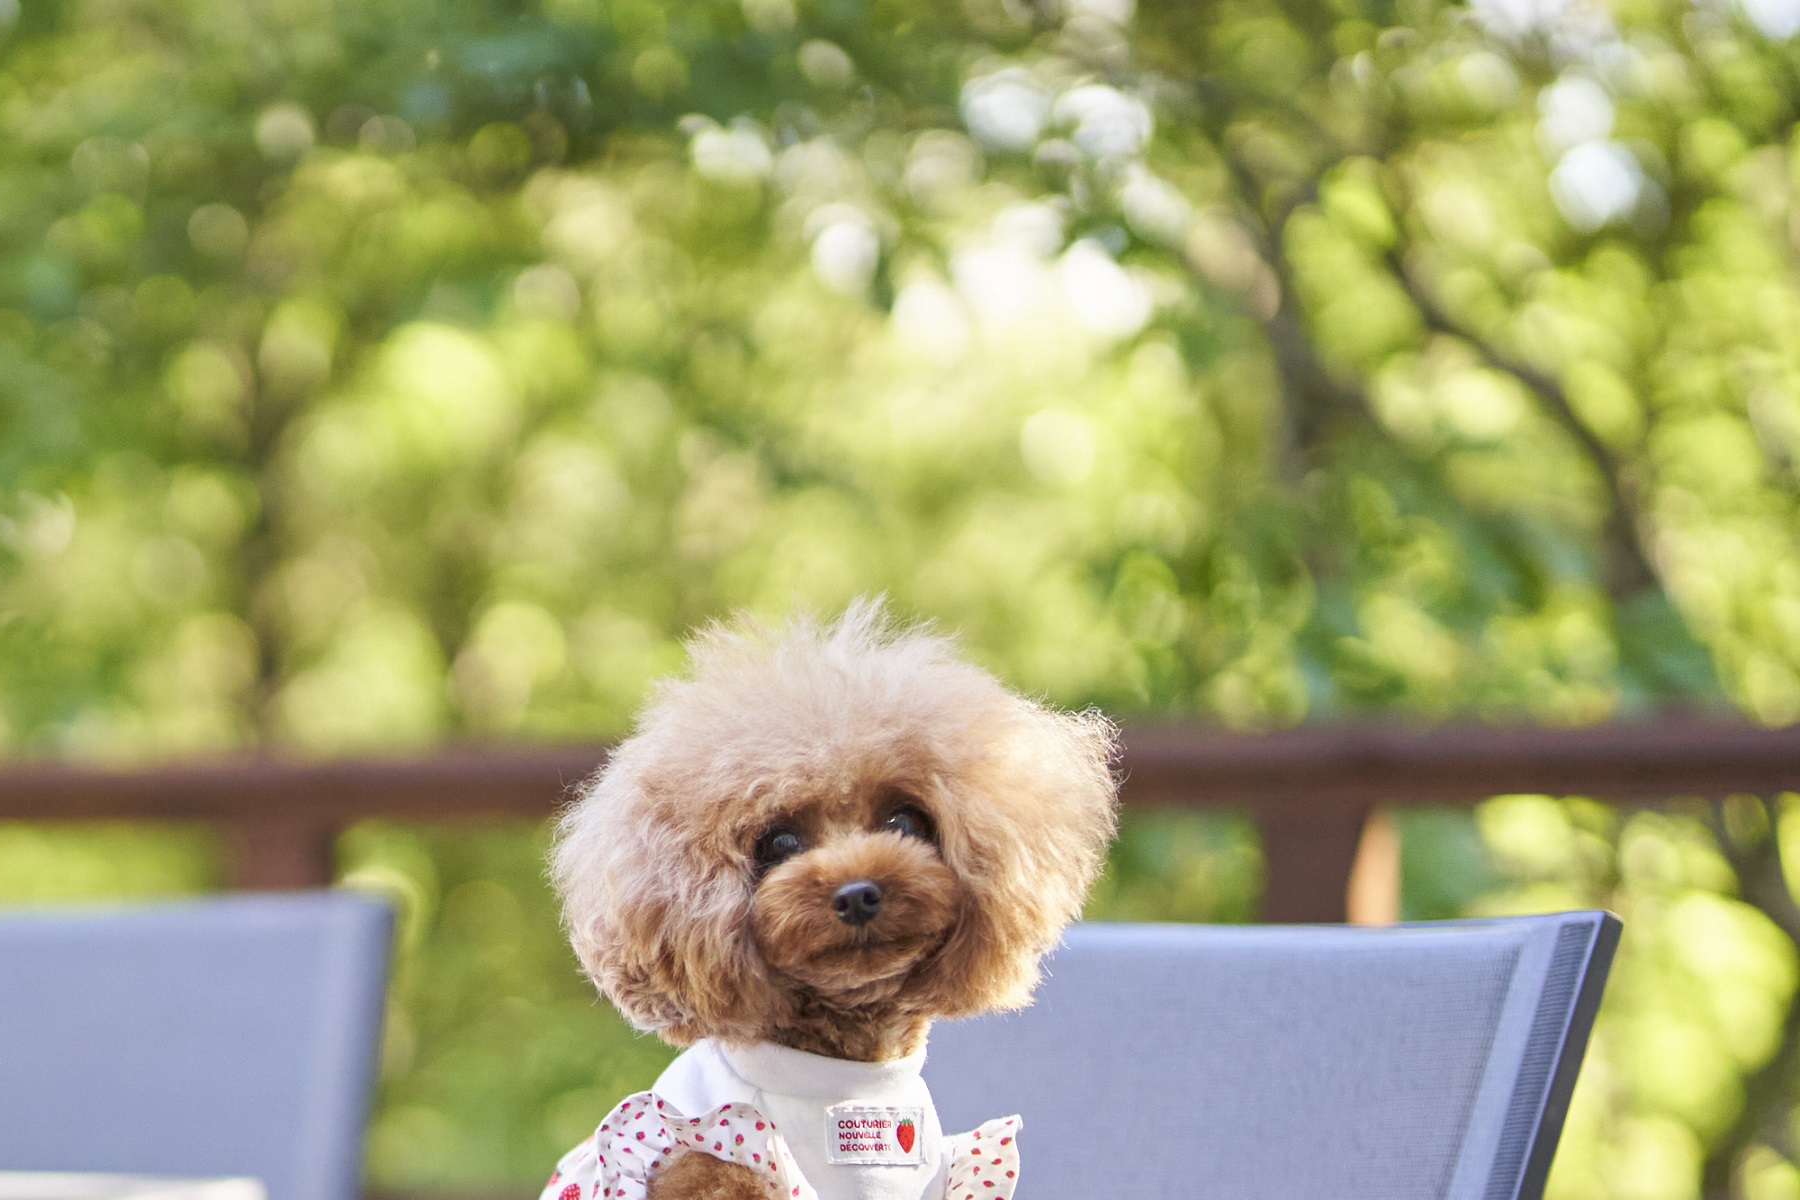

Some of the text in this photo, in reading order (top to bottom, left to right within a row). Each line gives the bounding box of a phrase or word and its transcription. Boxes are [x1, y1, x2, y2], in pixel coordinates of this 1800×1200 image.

[838, 1120, 892, 1129] COUTURIER
[839, 1131, 881, 1140] NOUVELLE
[840, 1141, 891, 1152] DÉCOUVERTE
